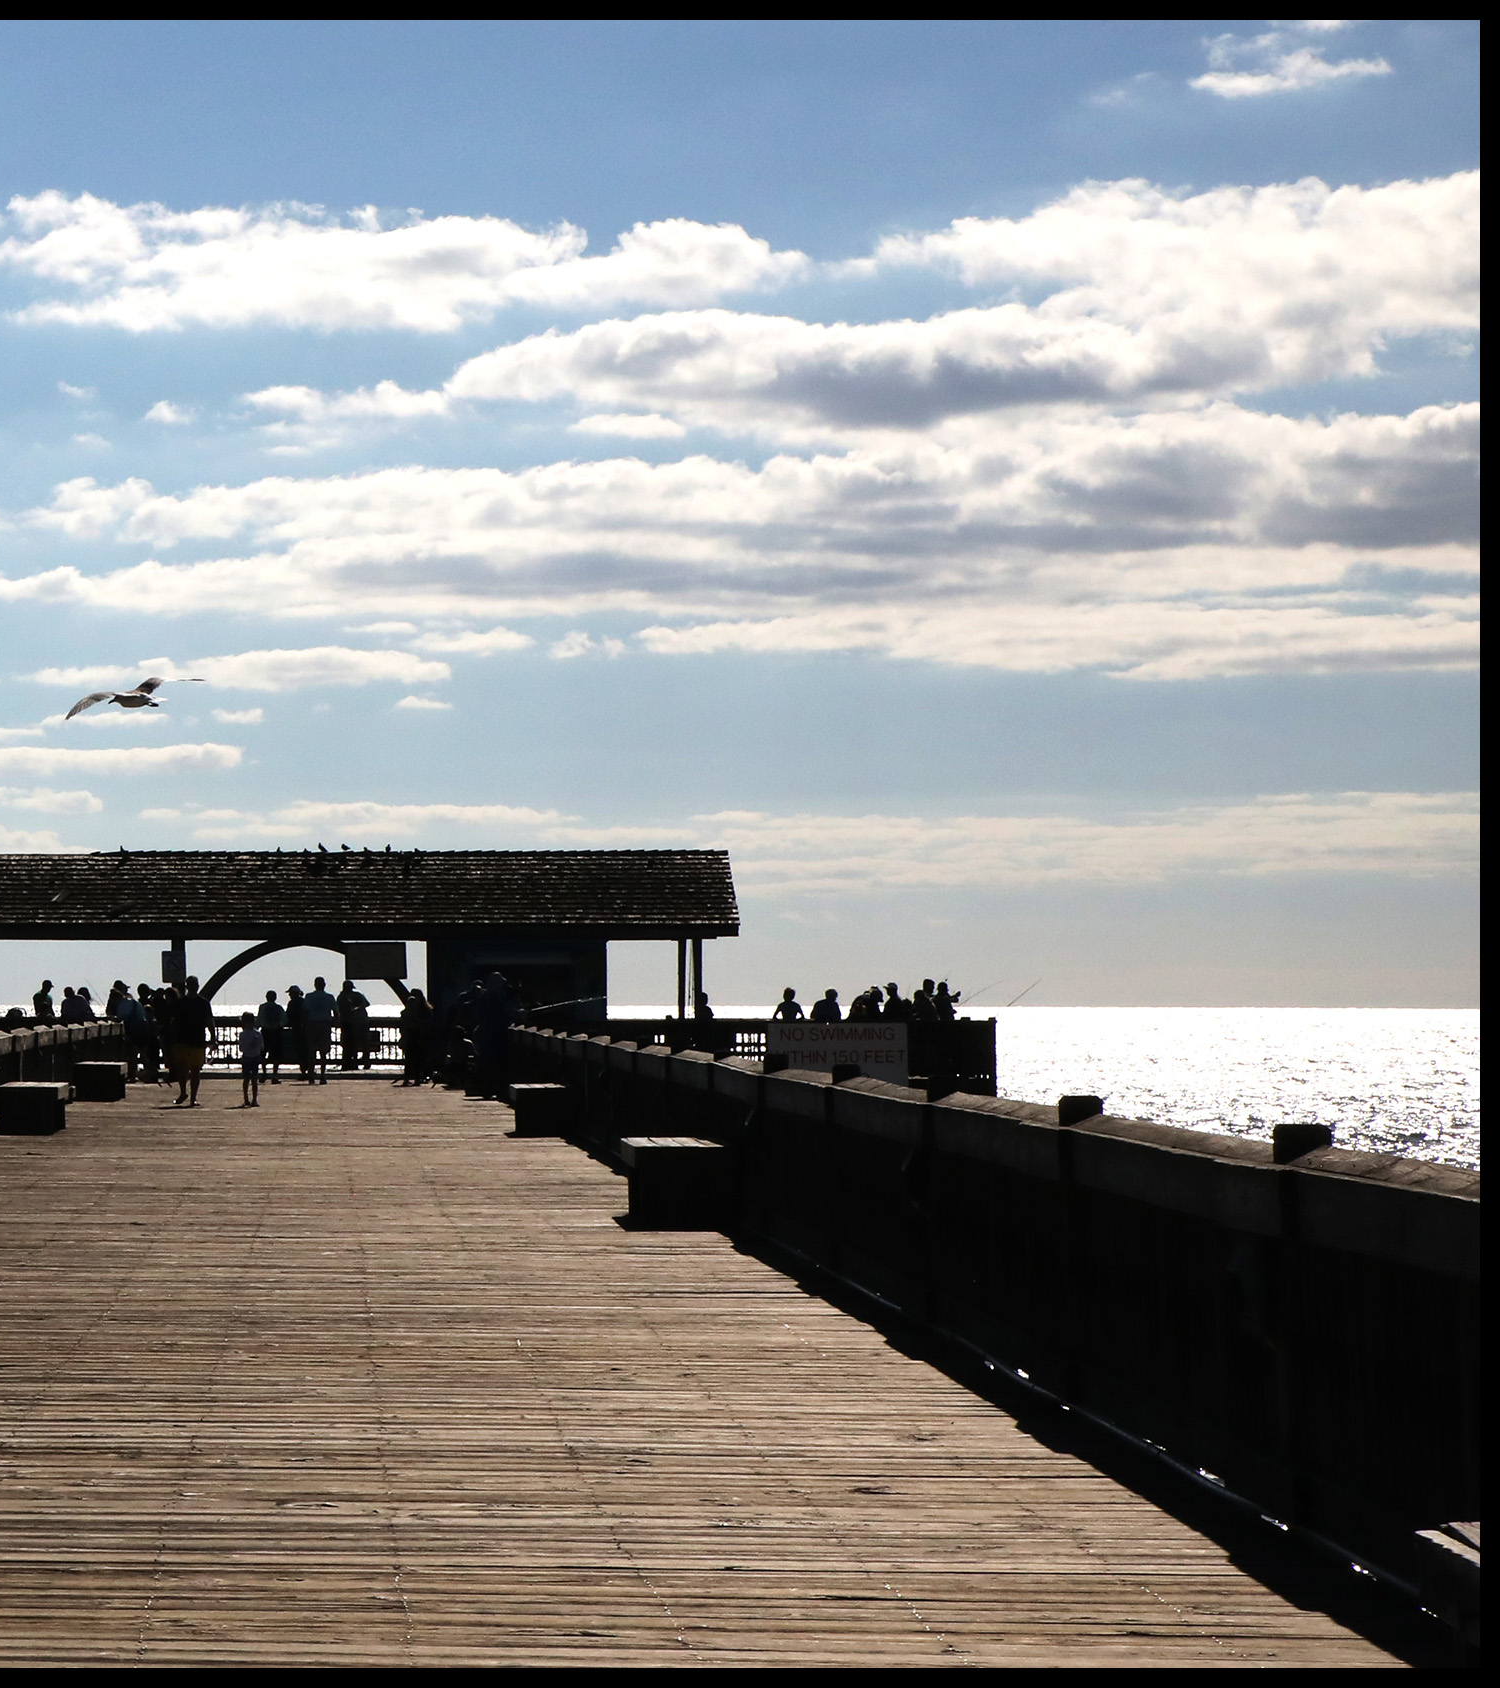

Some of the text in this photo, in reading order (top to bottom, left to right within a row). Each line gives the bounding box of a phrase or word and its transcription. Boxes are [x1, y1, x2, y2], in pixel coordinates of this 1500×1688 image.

[780, 1027, 896, 1041] NO SWIMMING
[768, 1050, 906, 1064] THIN 150 FEET
